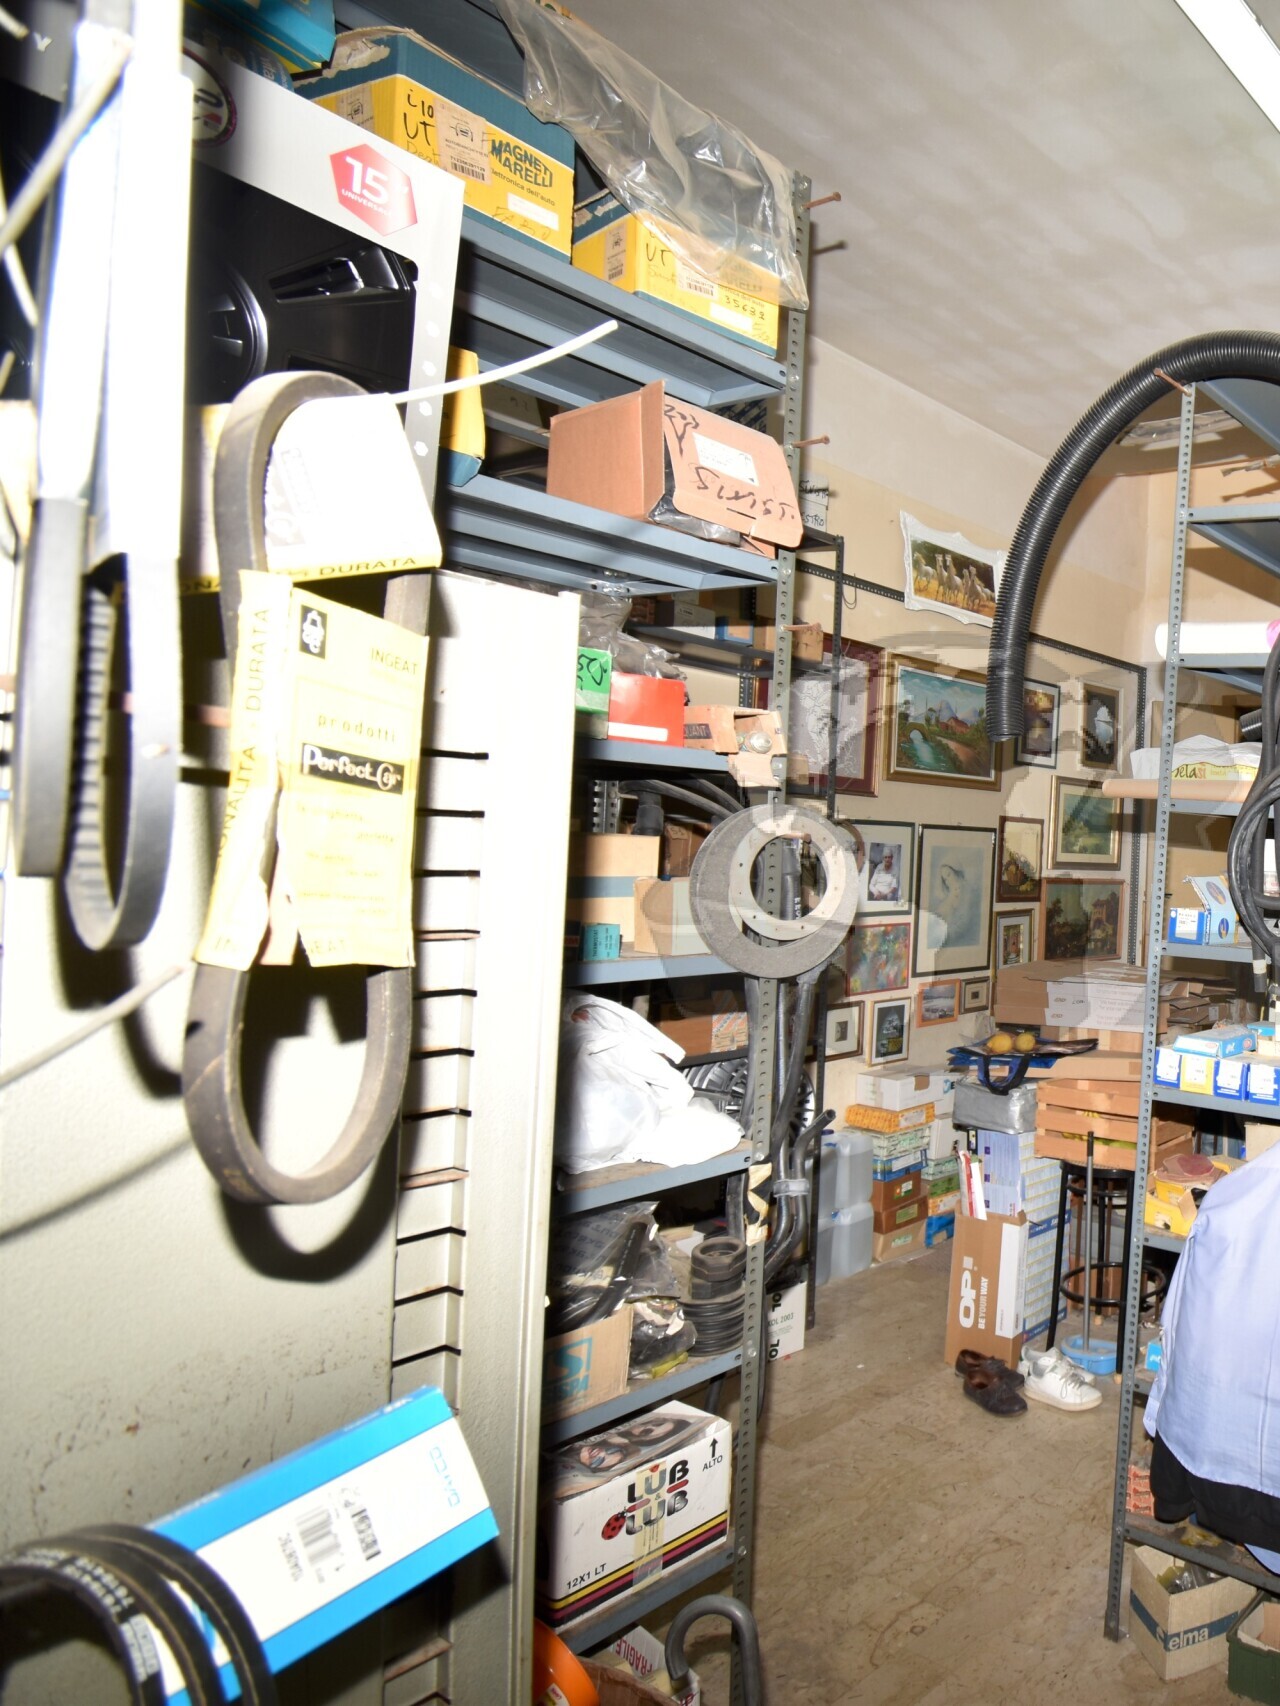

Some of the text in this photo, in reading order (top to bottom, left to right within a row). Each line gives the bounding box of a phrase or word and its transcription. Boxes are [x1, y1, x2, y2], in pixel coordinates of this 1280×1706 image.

[319, 556, 418, 578] DURATA
[245, 608, 270, 712] DURATA
[317, 714, 397, 743] prodotti
[978, 1276, 988, 1330] BE YOUR WAY
[628, 1460, 689, 1504] LUB
[702, 1455, 723, 1472] ALTO
[626, 1490, 689, 1536] LUB
[567, 1562, 607, 1590] 12X1 LT
[616, 1637, 654, 1677] FRAGILE
